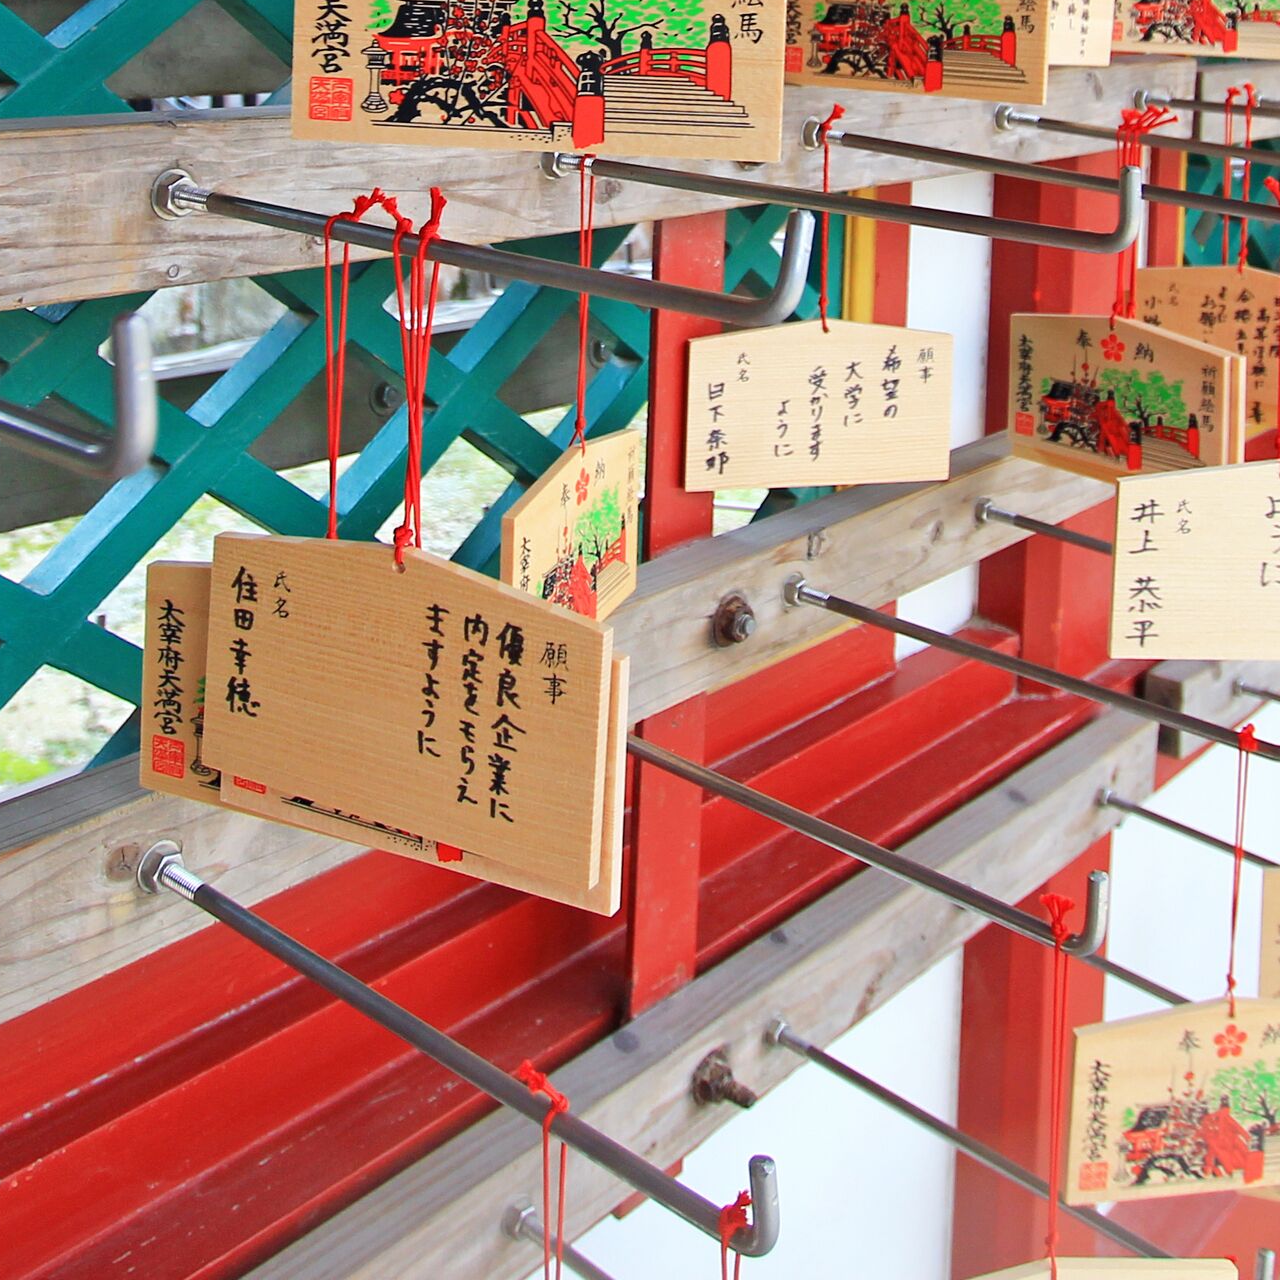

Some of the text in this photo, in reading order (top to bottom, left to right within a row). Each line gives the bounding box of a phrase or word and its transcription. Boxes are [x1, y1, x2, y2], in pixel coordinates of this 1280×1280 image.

[736, 351, 752, 383] 氏名
[843, 361, 865, 428] 大学に
[881, 345, 902, 419] 希望の
[916, 346, 935, 384] 願事
[774, 399, 795, 458] ように
[808, 365, 831, 463] 受かります
[1175, 498, 1193, 535] 氏名
[271, 569, 292, 620] 氏名
[1124, 499, 1165, 648] 井上恭平
[154, 599, 186, 735] 太宰府天満宮
[417, 603, 452, 759] ますように
[538, 641, 570, 706] 願事
[456, 613, 491, 807] 内定をもらえ
[489, 620, 527, 825] 優良企業に
